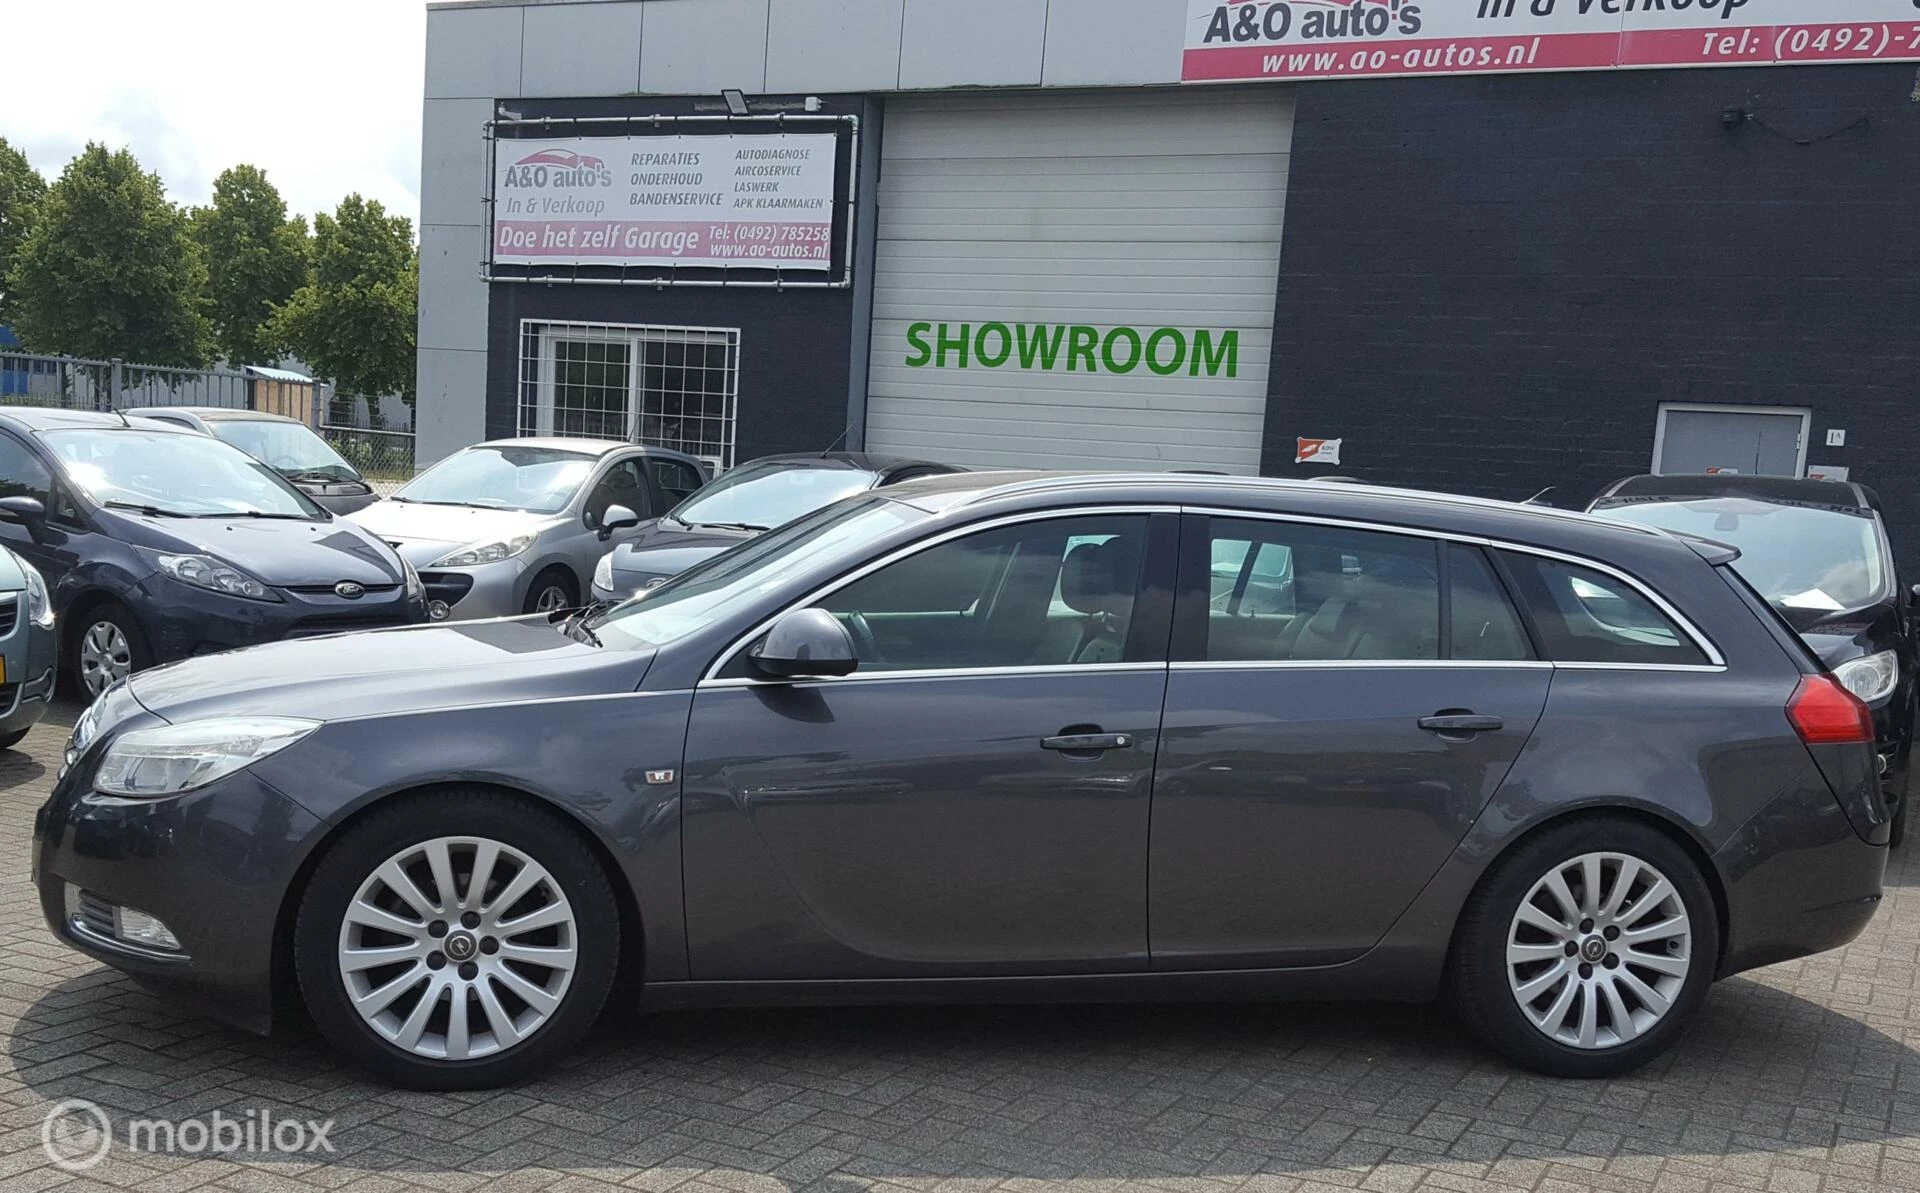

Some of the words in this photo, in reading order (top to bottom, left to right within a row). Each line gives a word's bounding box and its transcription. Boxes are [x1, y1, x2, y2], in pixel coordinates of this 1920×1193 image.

[1203, 3, 1292, 43] A&O
[1301, 0, 1422, 39] auto's
[1702, 29, 1760, 55] Tel:
[1263, 37, 1541, 73] www.ao-autos.nl
[631, 153, 700, 166] REPARATIES
[735, 149, 811, 160] AUTODIAGNOSE
[504, 165, 548, 188] A&O
[553, 162, 612, 188] auto's
[630, 173, 703, 186] ONDERHOUD
[734, 165, 802, 177] AIRCOSERVICE
[734, 182, 780, 193] LASWERK
[506, 198, 521, 213] In
[526, 199, 537, 213] &
[542, 196, 605, 217] Verkoop
[629, 193, 724, 206] BANDENSERVICE
[733, 199, 753, 209] APK
[755, 198, 824, 209] KLAARMAKEN
[500, 226, 537, 248] Doe
[542, 224, 577, 248] het
[580, 224, 621, 249] zelf
[625, 227, 700, 255] Garage
[709, 226, 730, 241] Tel:
[734, 224, 777, 244] (0492)
[781, 226, 830, 241] 785258
[710, 242, 828, 259] www.ao-autos.nl
[905, 321, 1239, 378] SHOWROOM
